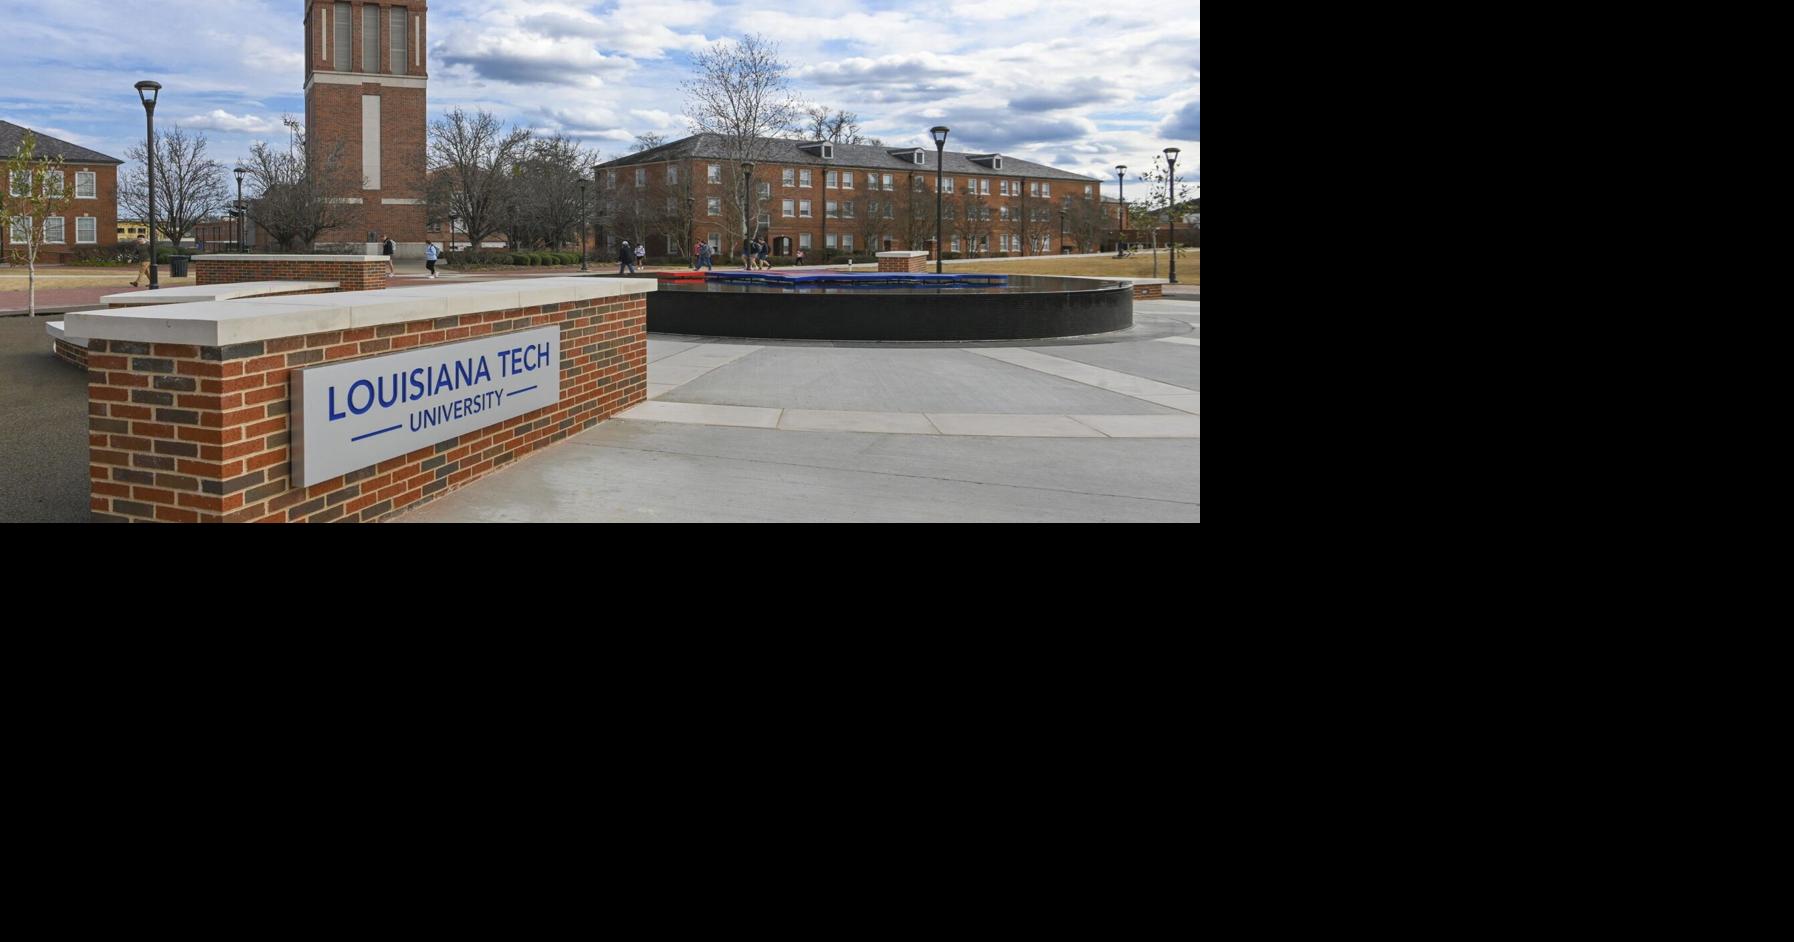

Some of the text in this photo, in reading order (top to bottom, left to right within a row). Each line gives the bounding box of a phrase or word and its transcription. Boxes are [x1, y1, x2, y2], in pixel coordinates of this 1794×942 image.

[328, 342, 550, 421] LOUISIANA TECH
[410, 388, 504, 432] UNIVERSITY
